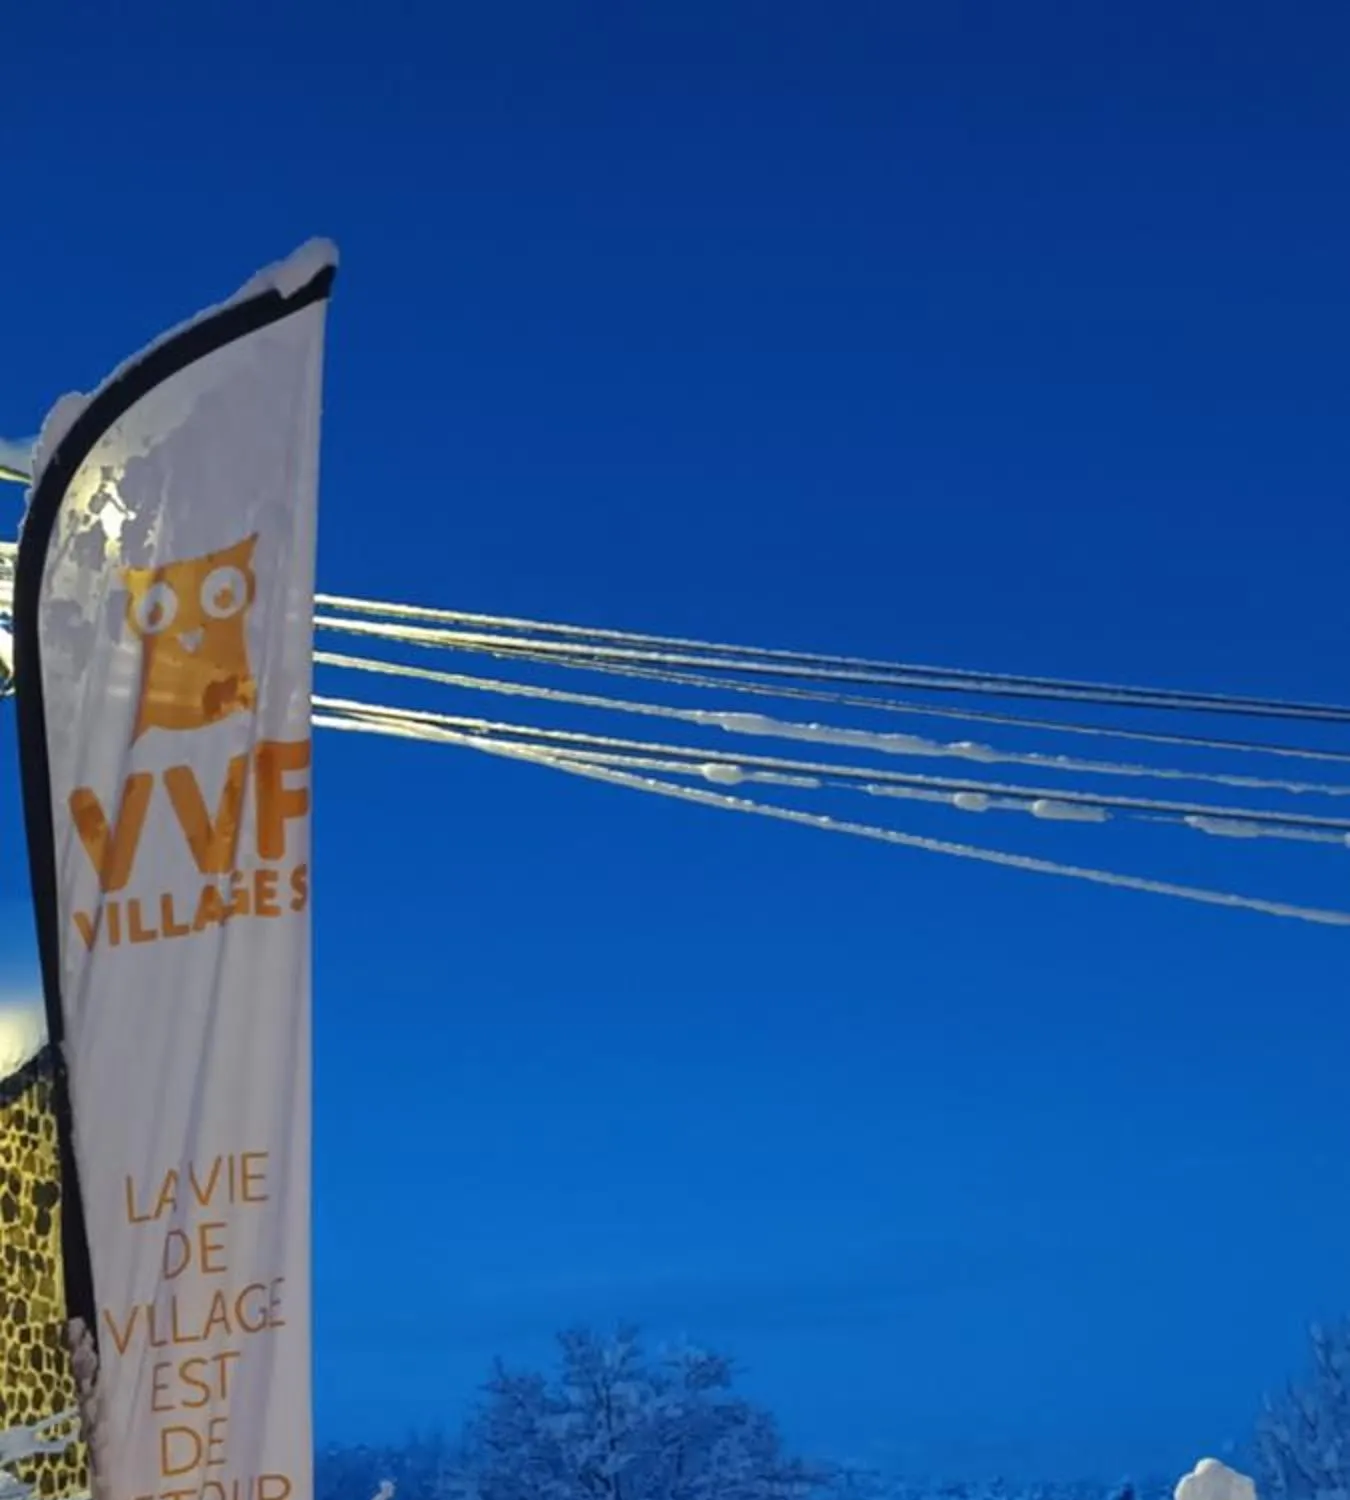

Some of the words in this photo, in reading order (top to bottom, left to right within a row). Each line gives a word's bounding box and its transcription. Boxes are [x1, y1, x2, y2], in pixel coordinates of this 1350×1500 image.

[68, 738, 310, 893] VVF
[72, 864, 307, 952] VILLAGES
[126, 1169, 178, 1223] LA
[188, 1152, 269, 1206] VIE
[163, 1221, 228, 1280] DE
[151, 1352, 240, 1412] EST
[160, 1417, 229, 1477] DE
